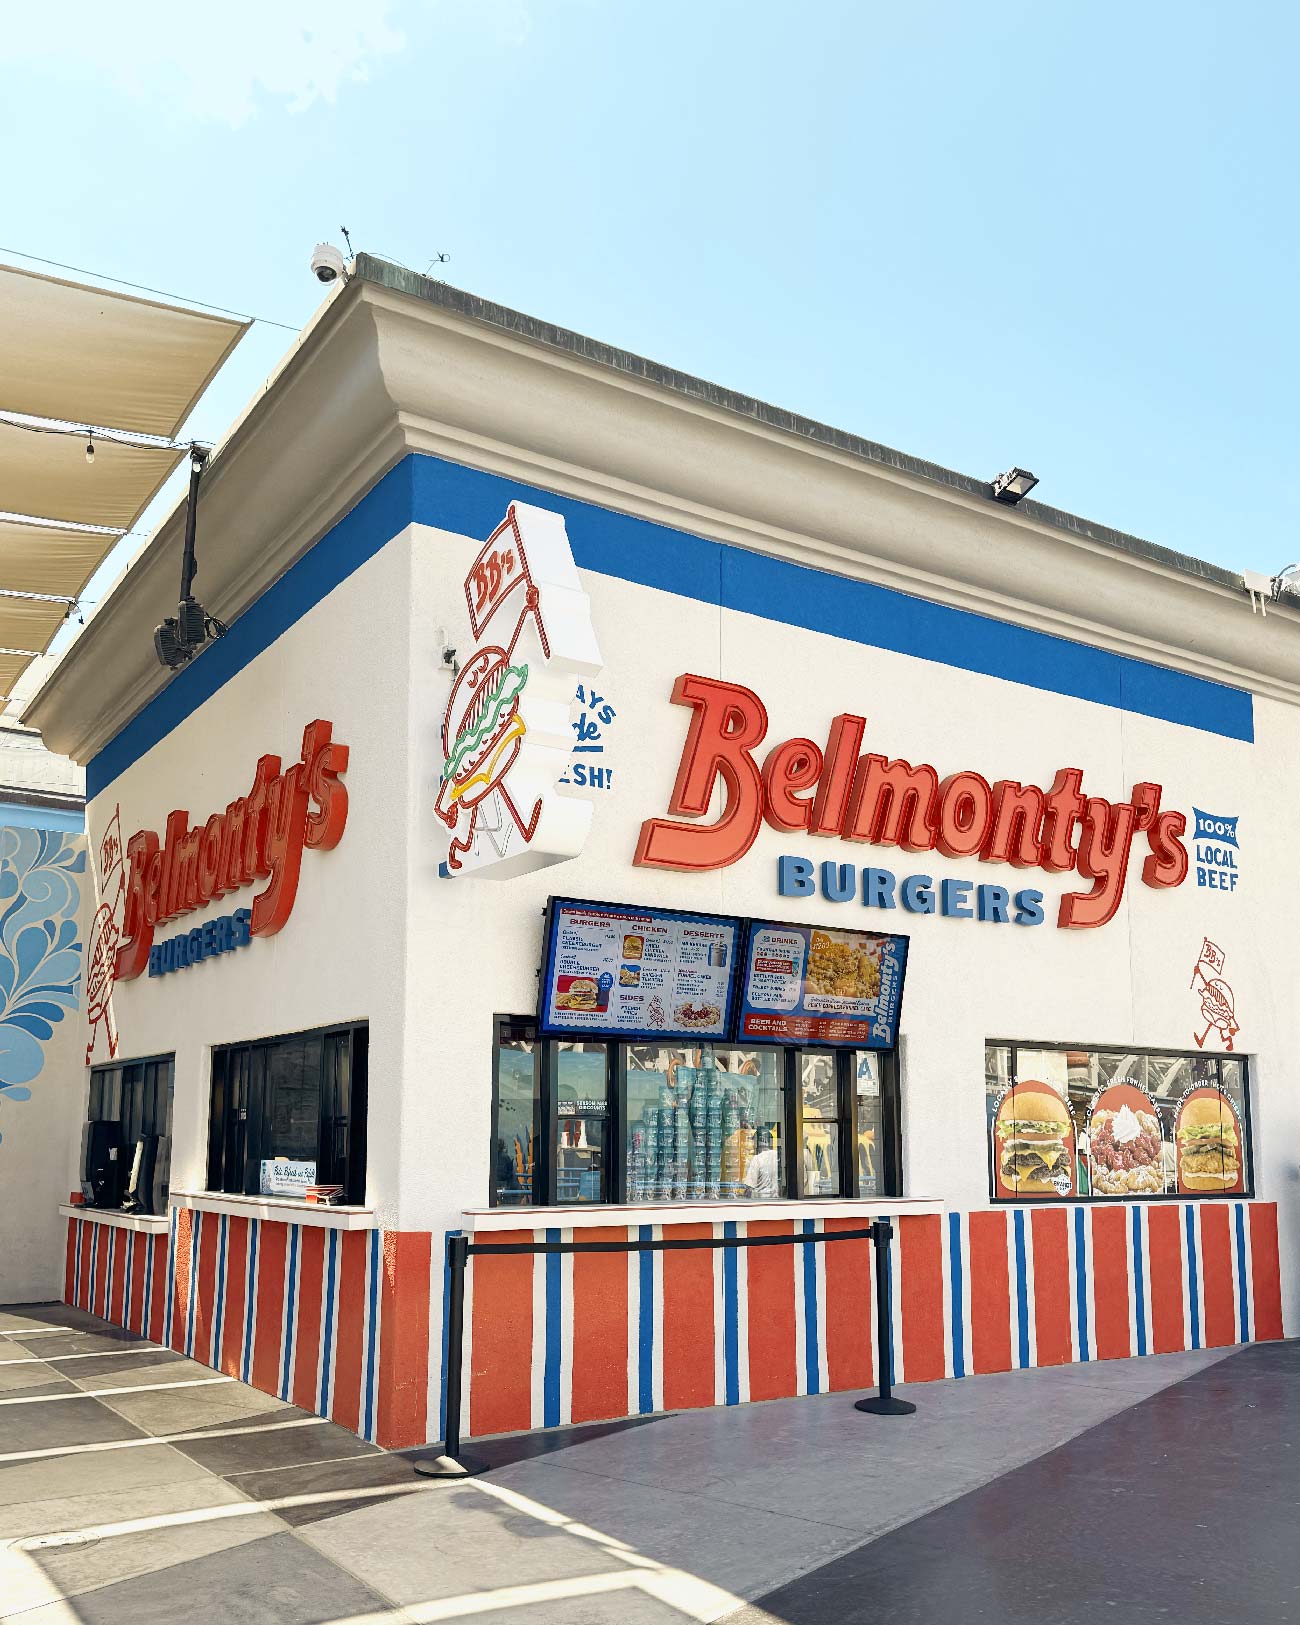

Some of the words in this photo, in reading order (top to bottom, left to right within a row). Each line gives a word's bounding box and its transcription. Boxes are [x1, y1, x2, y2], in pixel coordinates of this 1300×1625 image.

[473, 549, 515, 616] BB's
[558, 763, 613, 790] SH!
[632, 671, 1189, 931] Belmonty's
[1198, 818, 1235, 838] 100%
[113, 719, 349, 982] Belmonty's
[1196, 844, 1238, 870] LOCAL
[777, 853, 1045, 926] BURGERS
[1196, 866, 1239, 892] BEEF
[569, 918, 611, 928] BURGERS
[631, 924, 668, 934] CHICKEN
[683, 929, 725, 939] DESSERTS
[148, 908, 253, 978] BURGERS
[771, 936, 798, 945] DRINKS
[619, 994, 645, 1002] SIDES
[872, 942, 900, 1044] Belmonty's
[748, 1024, 788, 1032] COCKTAILS
[857, 1057, 873, 1080] A
